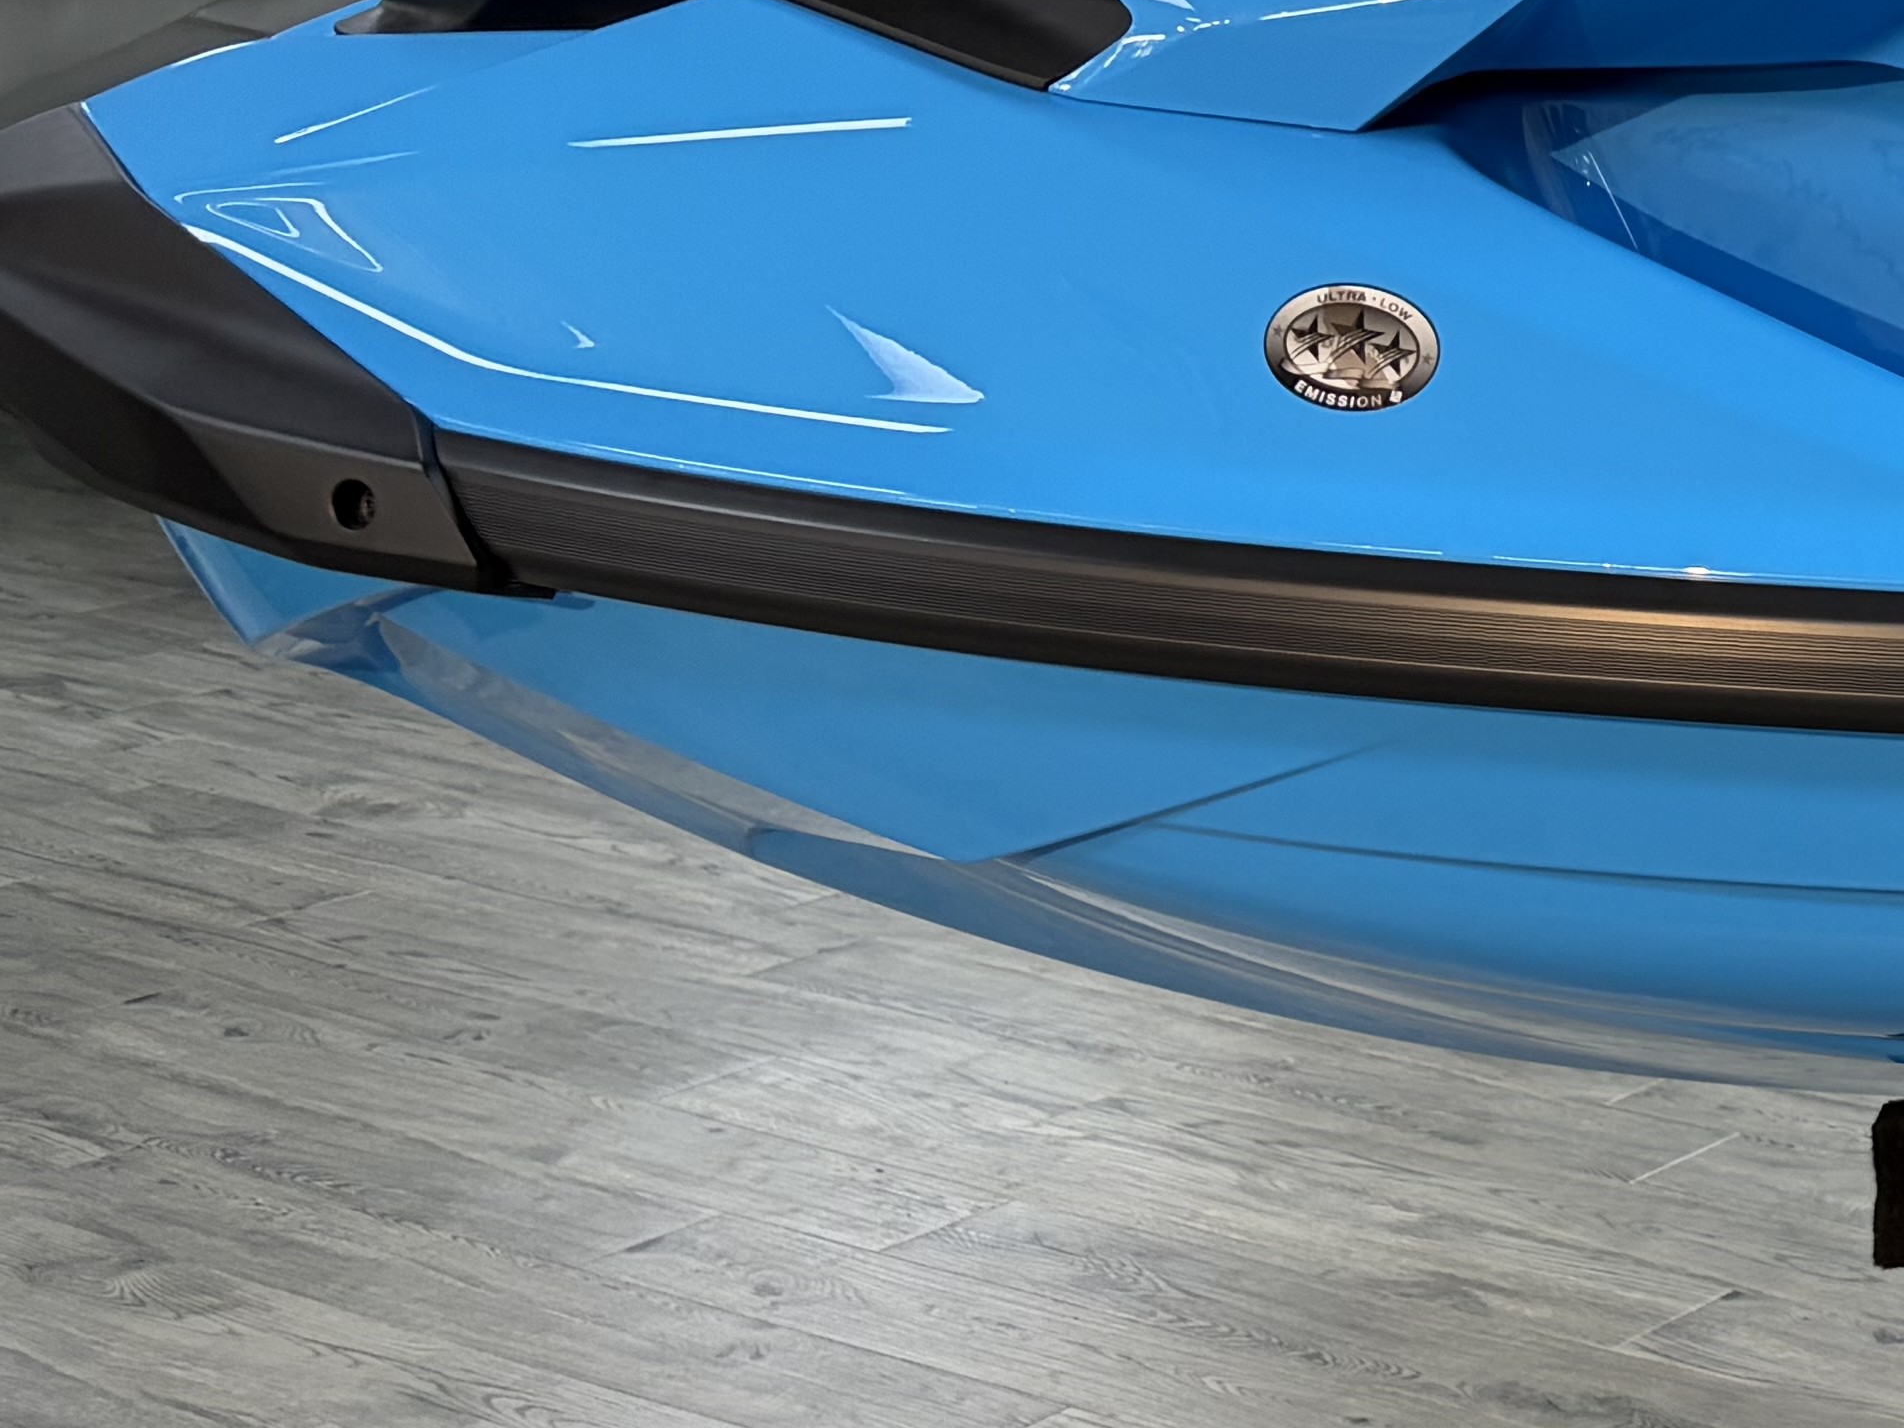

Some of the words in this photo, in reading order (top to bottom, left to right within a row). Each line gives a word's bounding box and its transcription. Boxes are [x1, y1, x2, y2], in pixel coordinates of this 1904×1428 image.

[1316, 289, 1367, 304] ULTRA
[1379, 297, 1413, 321] LOW
[1294, 378, 1383, 408] EMISSION
